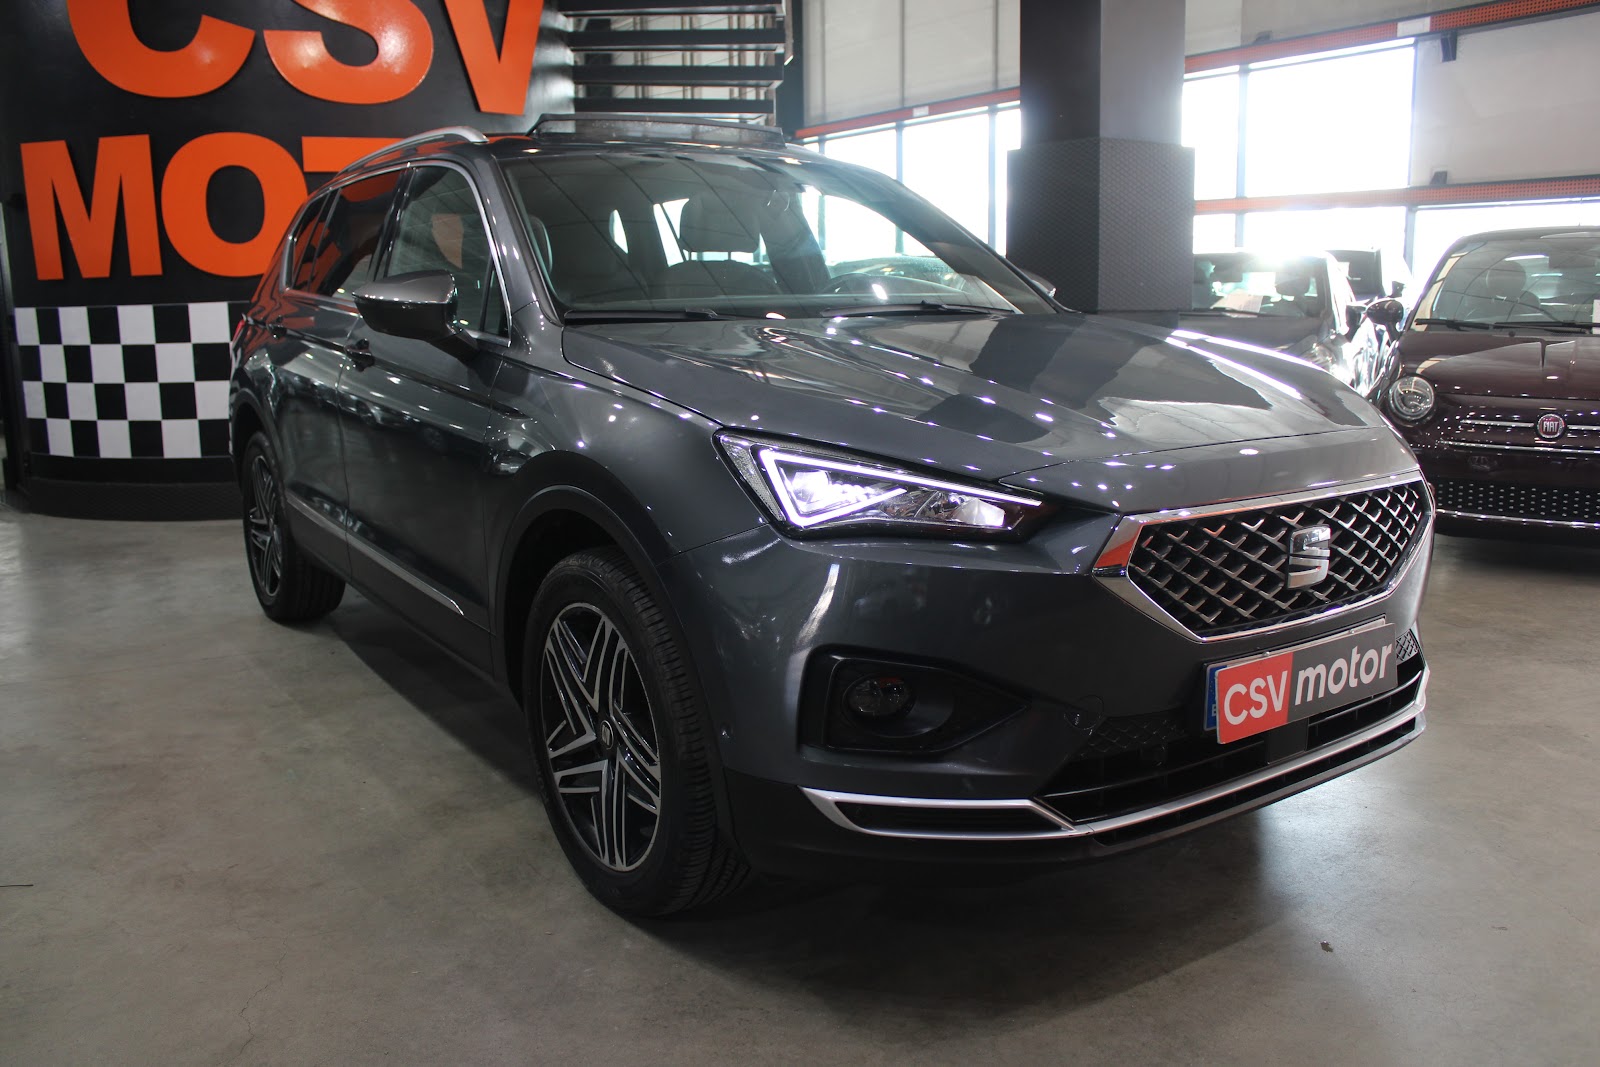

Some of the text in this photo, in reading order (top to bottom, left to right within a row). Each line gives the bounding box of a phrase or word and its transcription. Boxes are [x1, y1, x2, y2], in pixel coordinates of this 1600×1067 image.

[1543, 421, 1559, 432] FIAT
[1224, 643, 1393, 725] CSV motor
